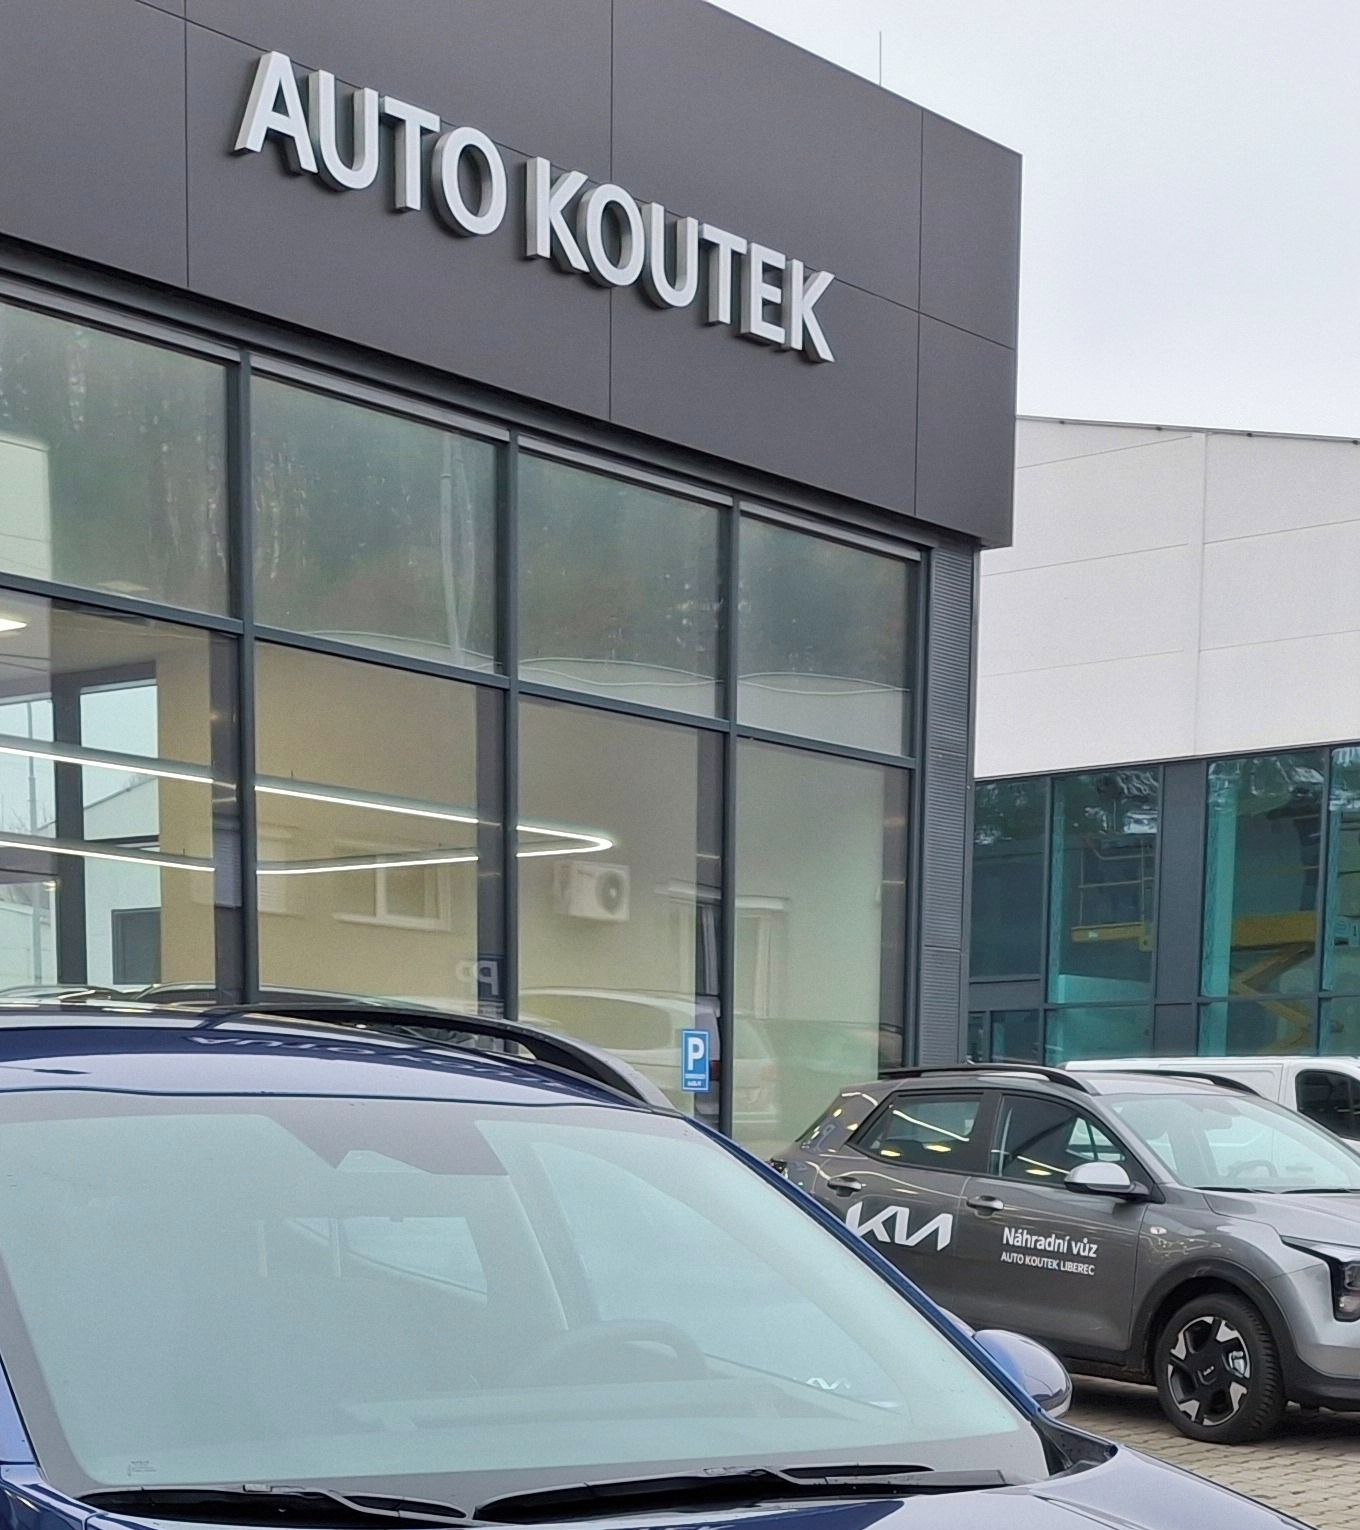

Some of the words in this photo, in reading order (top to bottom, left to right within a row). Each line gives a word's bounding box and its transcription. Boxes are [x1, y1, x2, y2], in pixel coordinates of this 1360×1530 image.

[234, 51, 508, 236] AUTO
[525, 156, 835, 363] KOUTEK
[687, 1037, 705, 1070] P
[846, 1201, 953, 1251] KIA
[1003, 1227, 1069, 1253] Náhradní
[1071, 1237, 1098, 1258] vůz
[1000, 1251, 1024, 1265] AUTO
[1025, 1255, 1059, 1271] KOUTEK
[1060, 1262, 1095, 1276] LIBEREC
